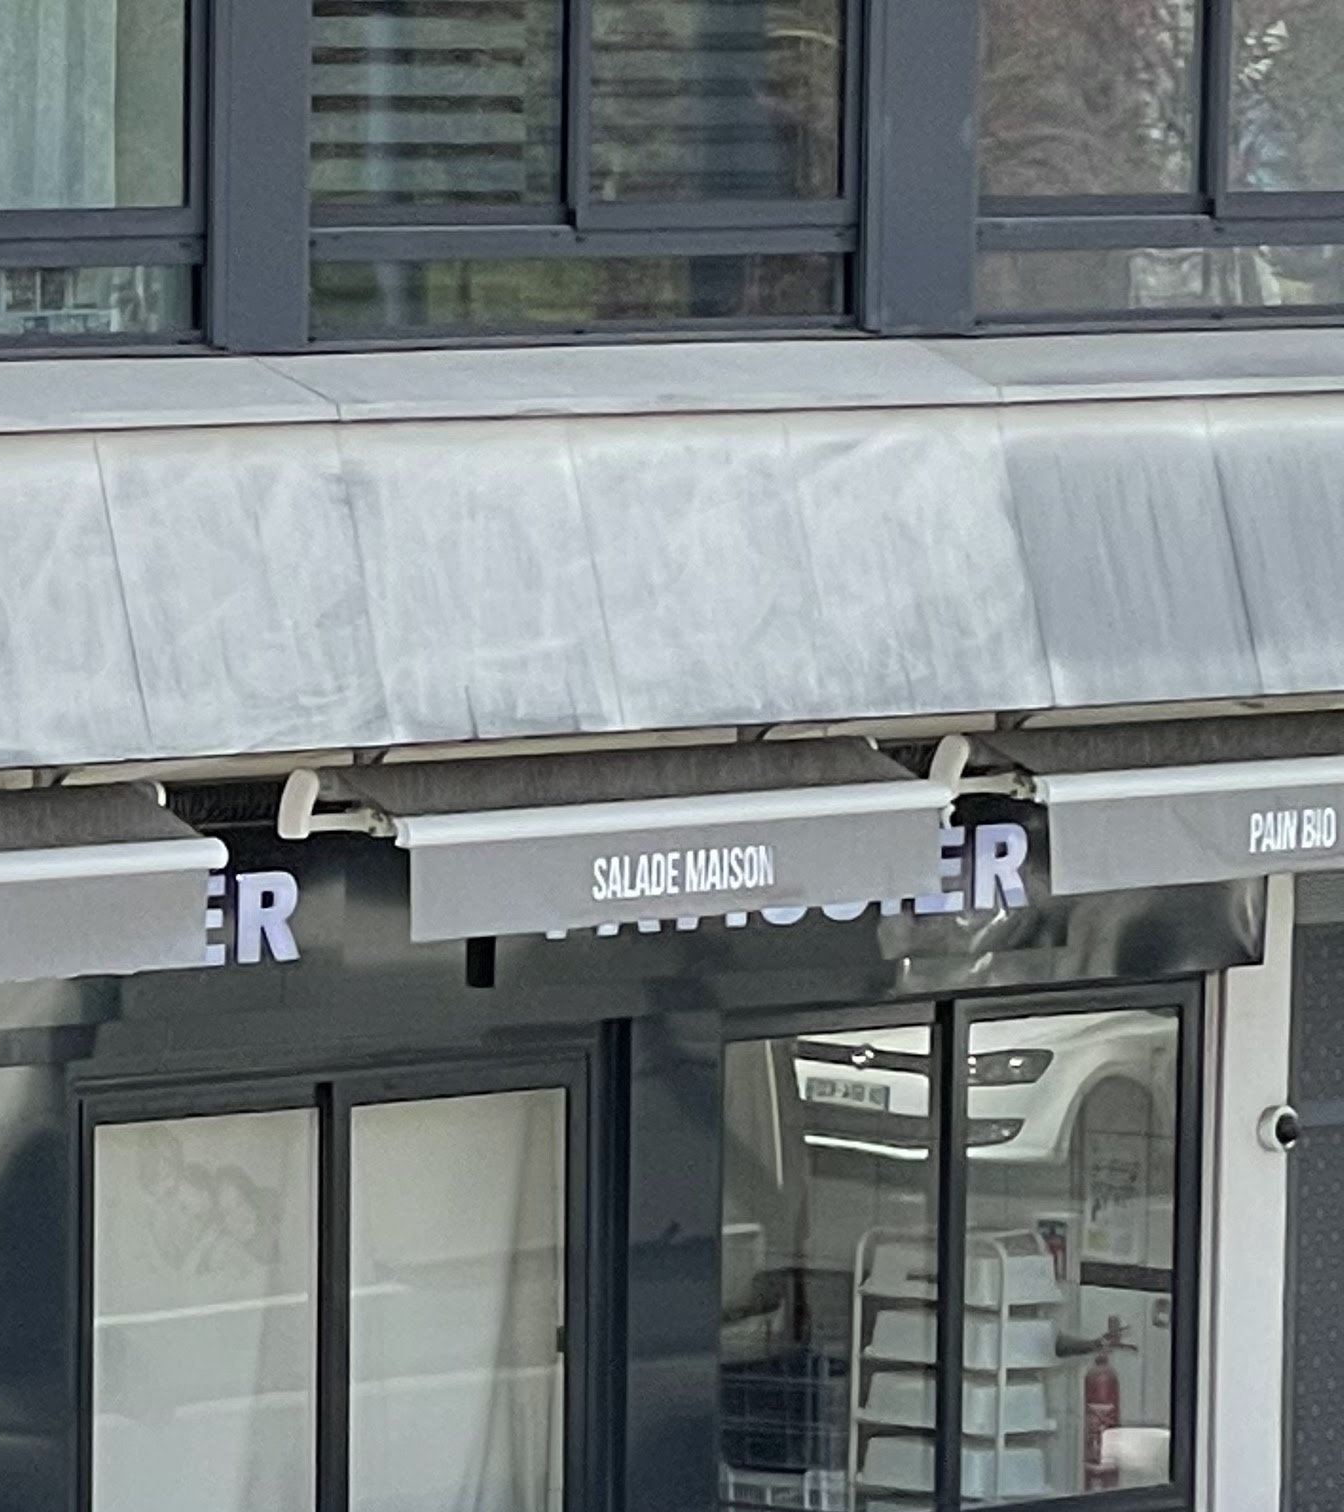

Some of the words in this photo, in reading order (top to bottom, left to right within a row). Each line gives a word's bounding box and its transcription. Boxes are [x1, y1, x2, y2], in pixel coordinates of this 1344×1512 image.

[1249, 810, 1297, 853] PAIN
[1301, 806, 1337, 849] BIO
[592, 851, 681, 901] SALADE
[685, 844, 775, 893] MAISON
